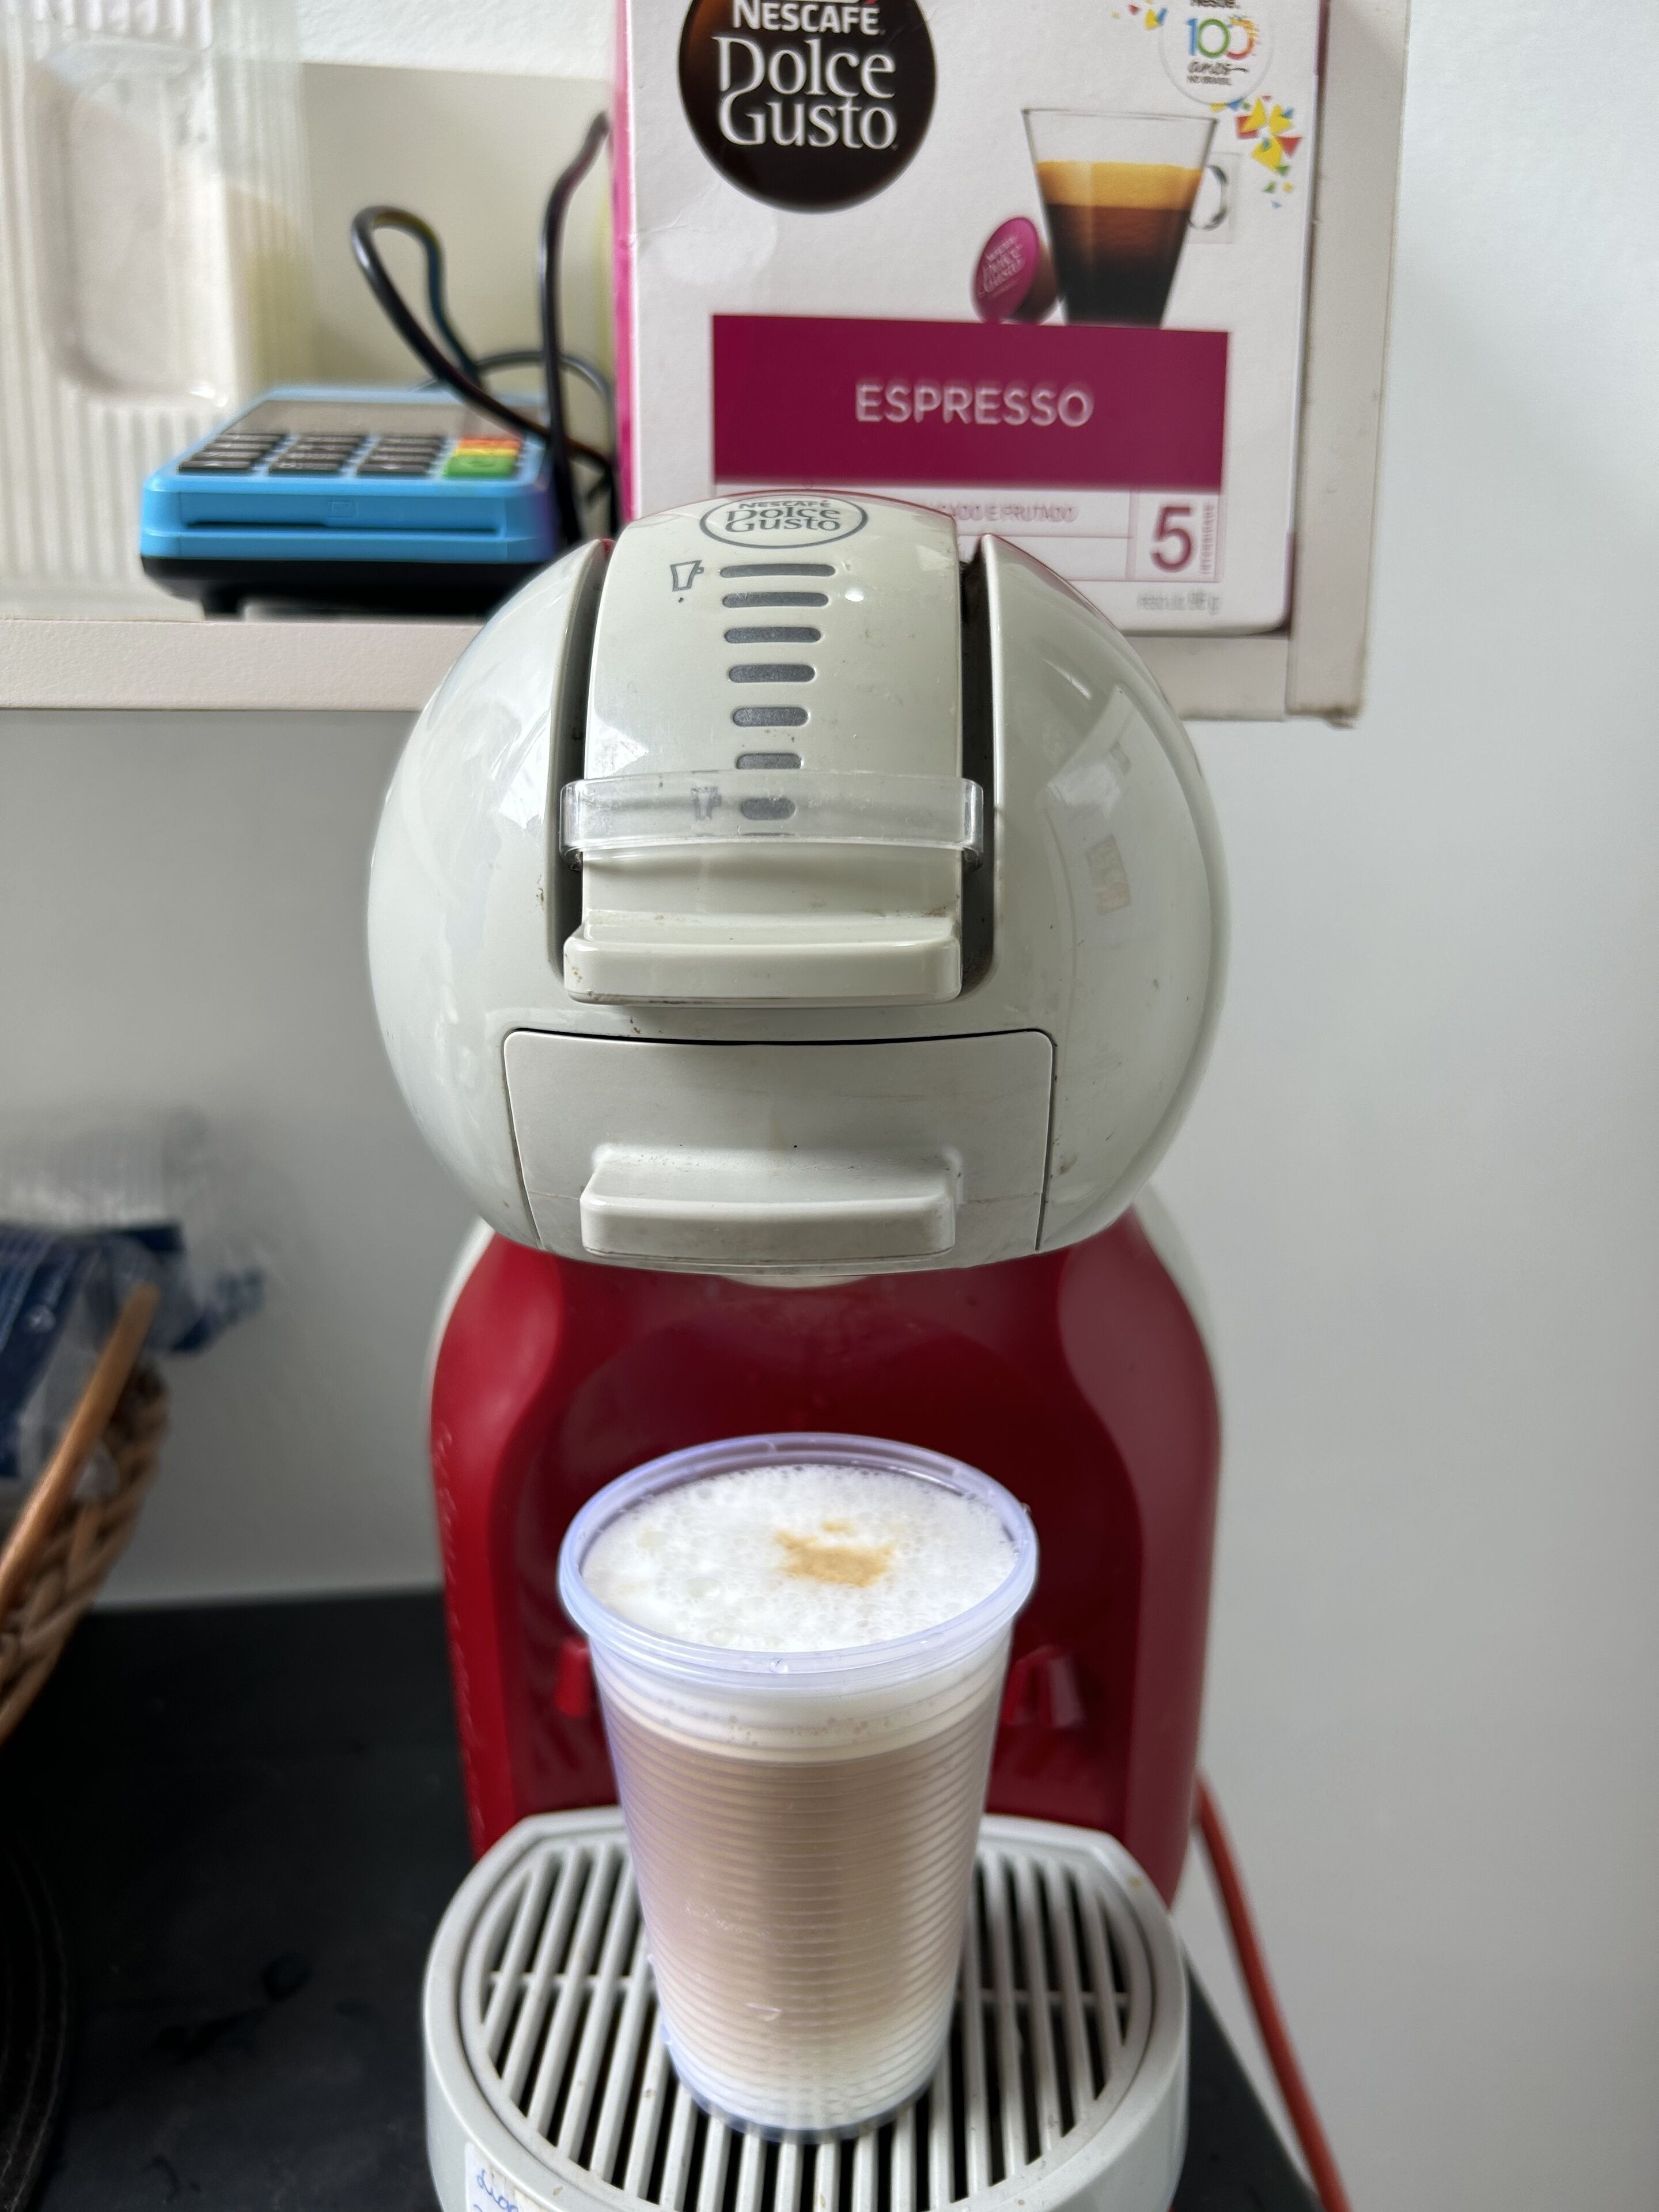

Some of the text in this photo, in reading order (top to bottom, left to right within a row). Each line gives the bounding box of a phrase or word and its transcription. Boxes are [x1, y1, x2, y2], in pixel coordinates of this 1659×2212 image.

[711, 36, 896, 99] Dolce
[718, 96, 897, 150] Gusto
[855, 380, 1094, 427] ESPRESSO
[725, 517, 840, 532] Gusto
[726, 507, 841, 521] Dolce
[1150, 505, 1194, 573] 5
